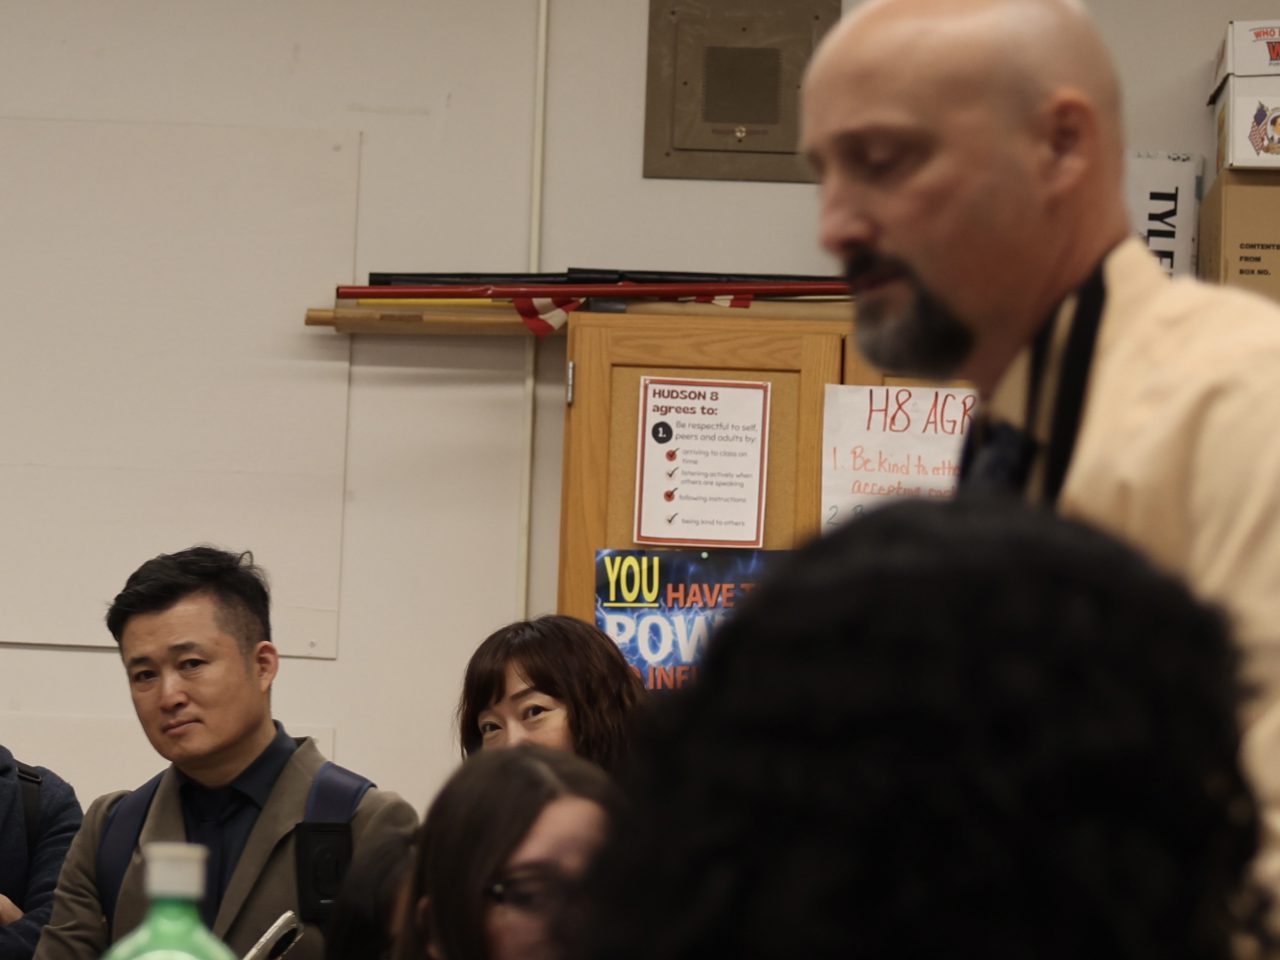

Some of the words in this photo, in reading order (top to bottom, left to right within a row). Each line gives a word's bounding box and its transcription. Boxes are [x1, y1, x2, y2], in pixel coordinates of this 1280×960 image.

[652, 388, 707, 400] HUDSON
[709, 391, 719, 401] 8
[652, 404, 697, 416] agrees
[700, 405, 718, 416] to:
[866, 388, 912, 433] H8
[658, 427, 666, 437] 1.
[675, 421, 686, 429] Be
[688, 422, 729, 431] respectful
[731, 423, 740, 431] to
[742, 424, 758, 432] self,
[675, 434, 698, 442] peers
[700, 434, 716, 442] and
[717, 434, 743, 442] adults
[681, 449, 709, 458] arriving
[710, 449, 719, 457] to
[719, 450, 737, 458] class
[851, 445, 875, 473] Be
[878, 451, 910, 475] kind
[915, 455, 928, 475] to
[681, 470, 708, 479] listening
[708, 471, 734, 479] actively
[715, 481, 744, 489] speaking
[679, 494, 707, 503] following
[708, 495, 747, 504] instructions
[603, 555, 660, 602] YOU
[666, 582, 737, 608] HAVE
[606, 614, 716, 663] POW
[647, 665, 699, 690] INF
